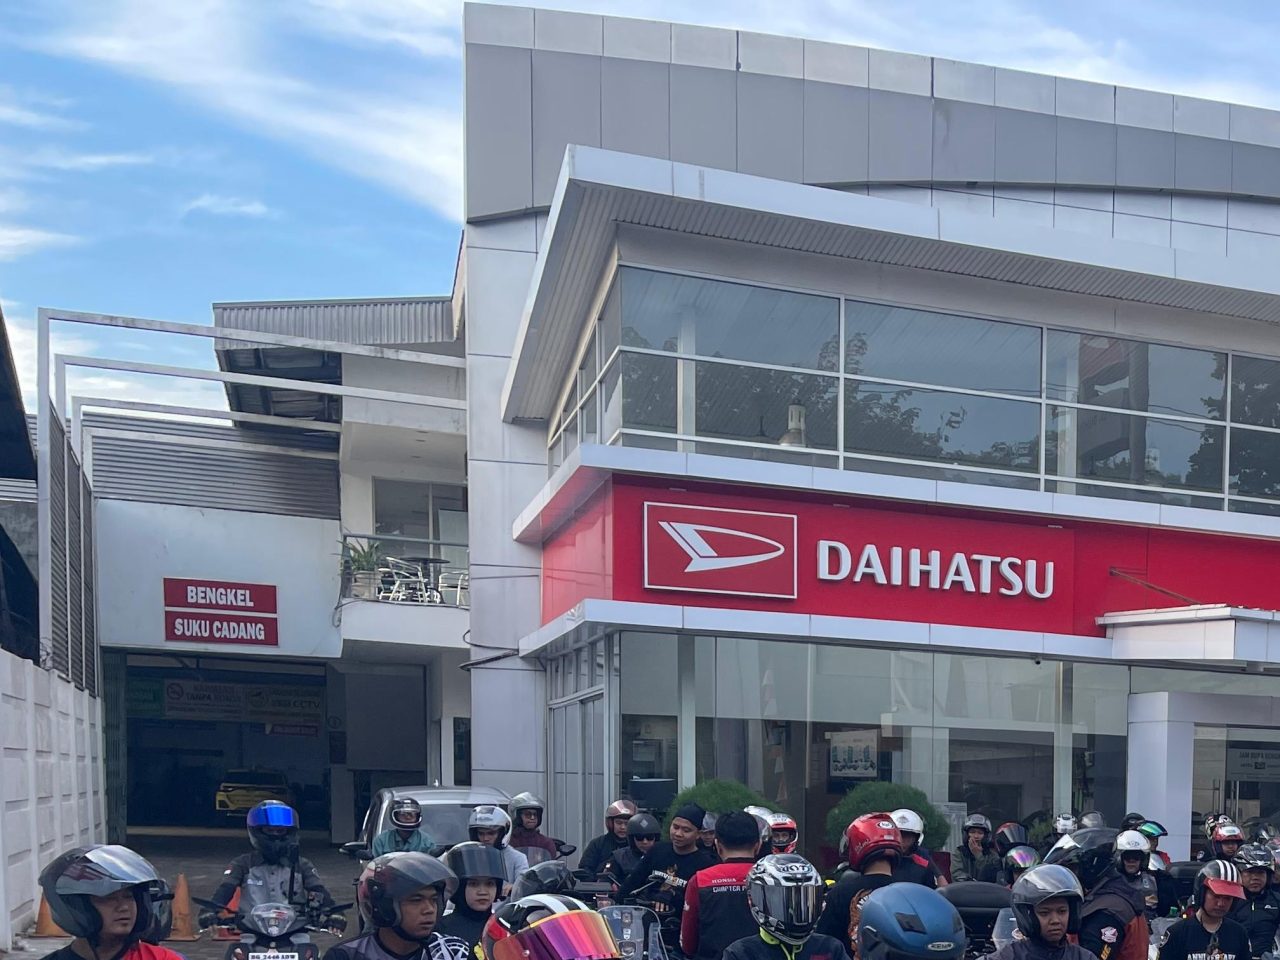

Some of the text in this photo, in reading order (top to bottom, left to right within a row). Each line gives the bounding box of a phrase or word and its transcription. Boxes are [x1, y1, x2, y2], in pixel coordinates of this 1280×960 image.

[817, 540, 1055, 598] DAIHATSU
[187, 585, 254, 607] BENGKEL
[174, 618, 265, 640] SUKU CADANG
